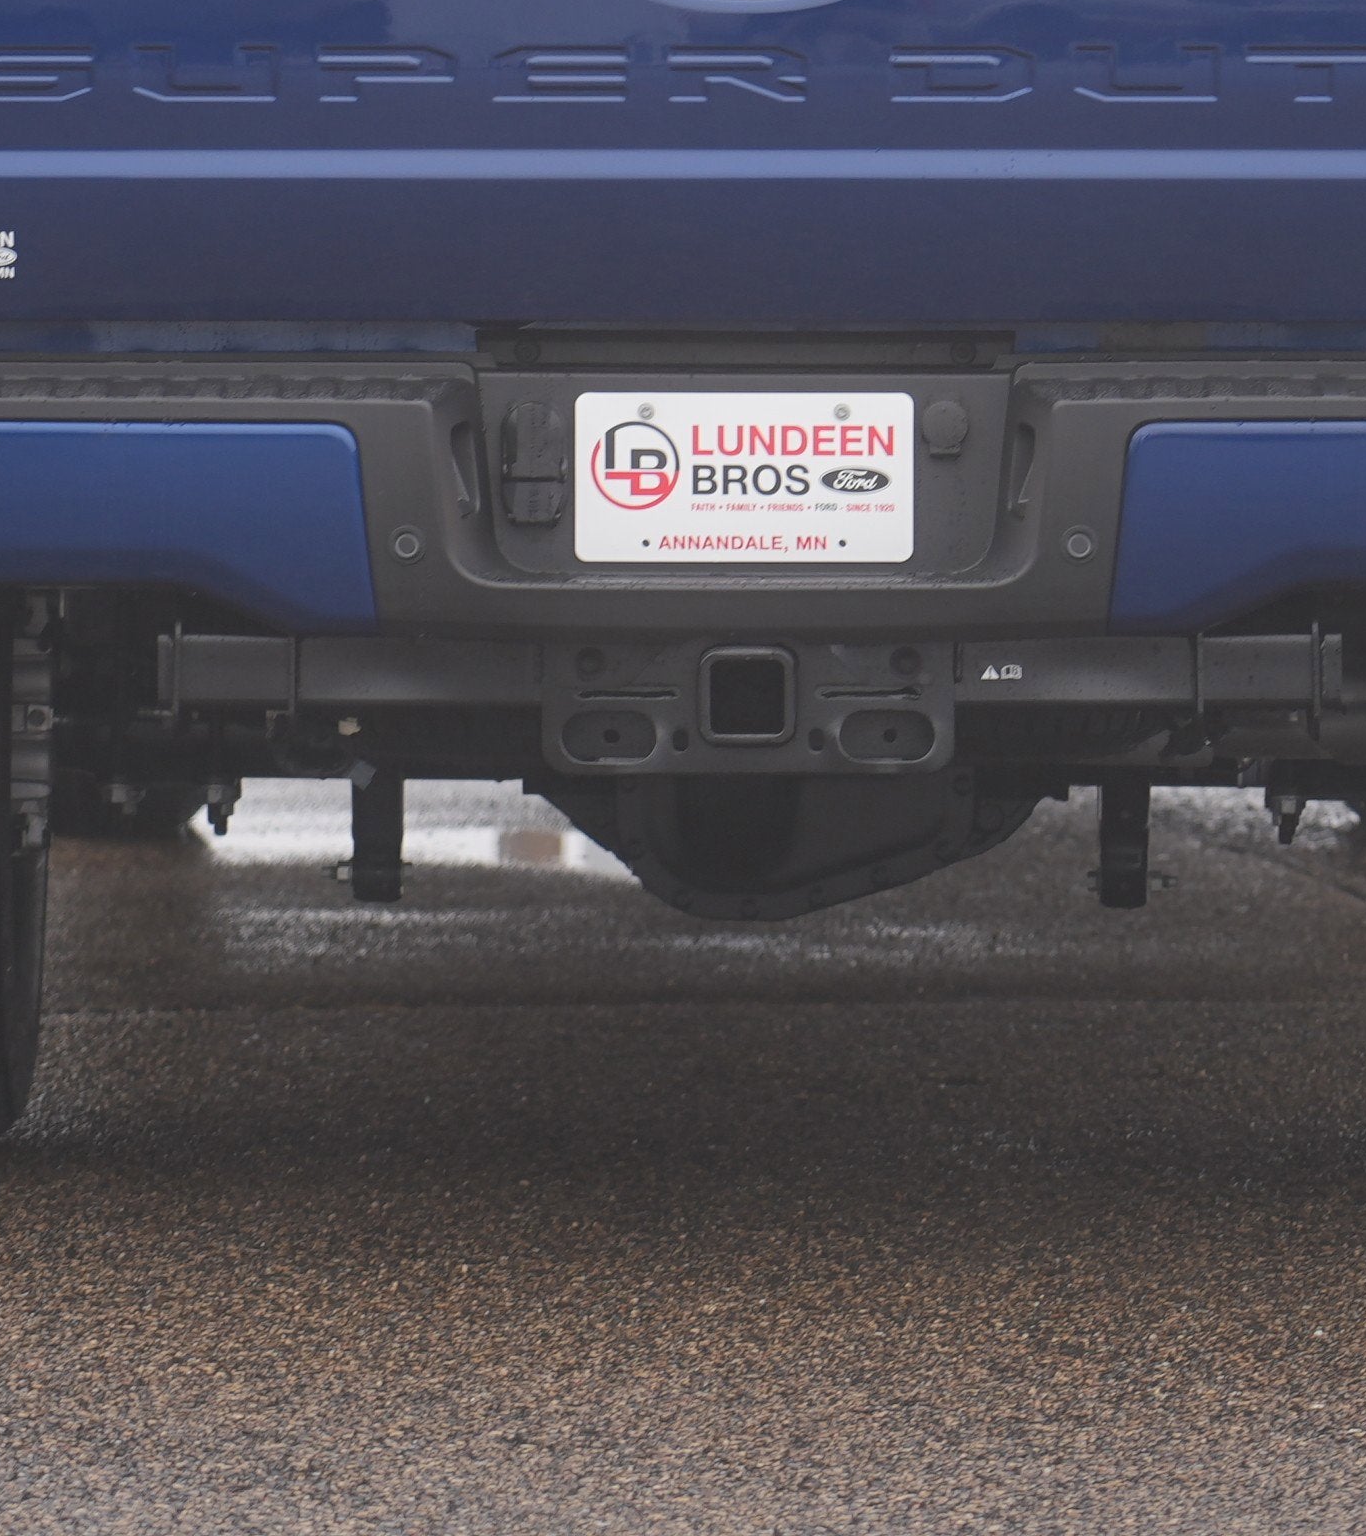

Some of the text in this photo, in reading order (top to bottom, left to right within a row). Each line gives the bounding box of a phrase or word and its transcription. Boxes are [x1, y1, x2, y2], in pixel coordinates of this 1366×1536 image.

[691, 425, 895, 456] LUNDEEN
[691, 464, 879, 497] BROS Ford
[691, 503, 716, 513] FAITH
[726, 503, 756, 513] FAMILY
[767, 503, 804, 513] FRIENDS
[814, 503, 838, 513] FORD
[846, 503, 871, 513] SINCE
[658, 535, 828, 553] ANNANDALE, MN
